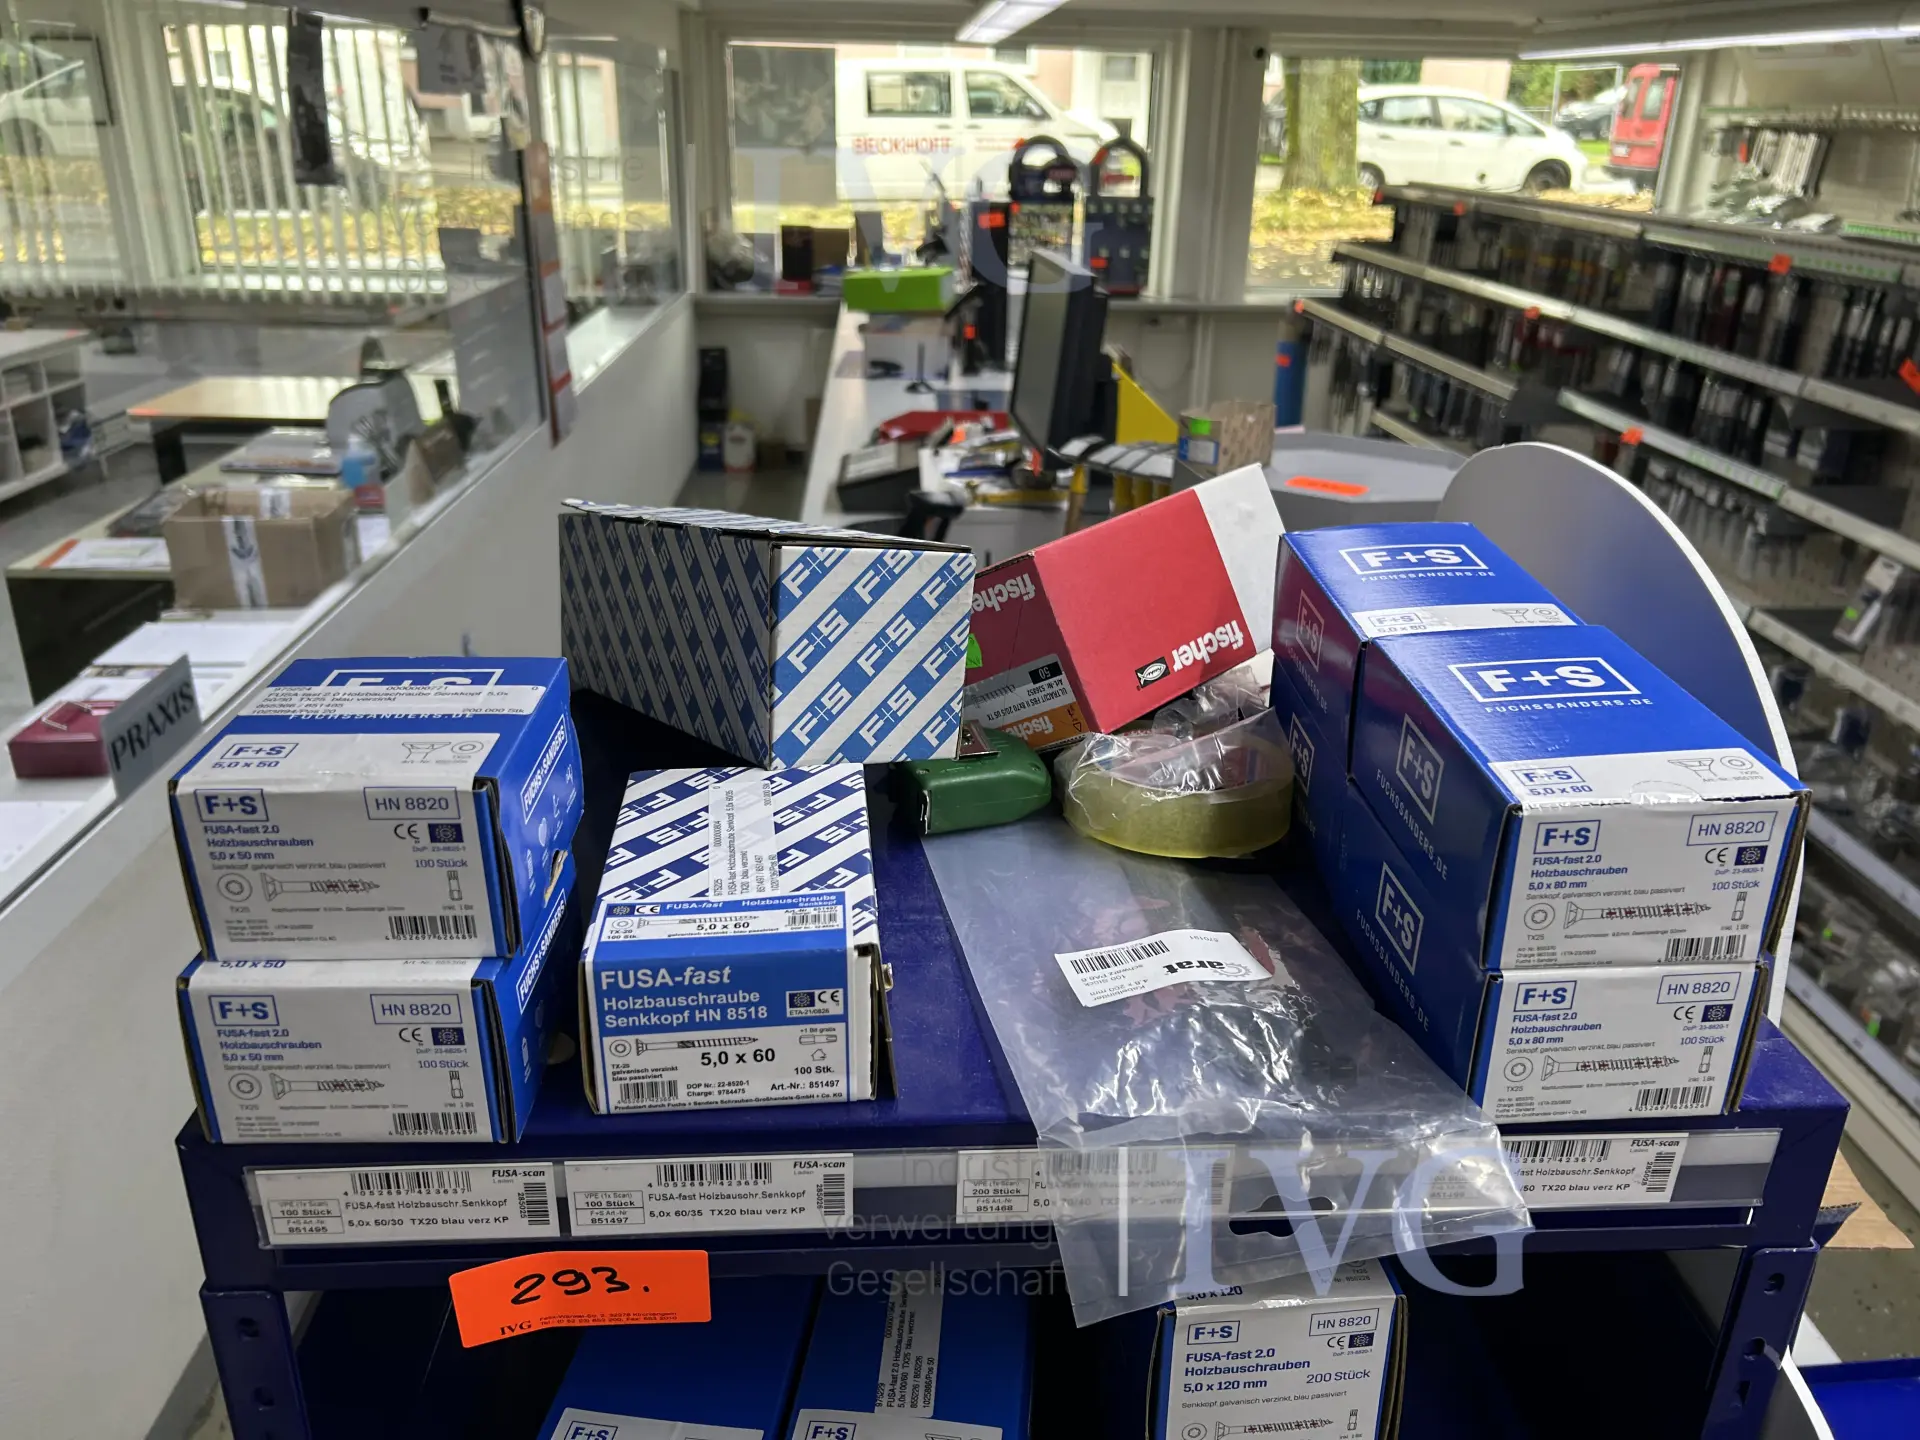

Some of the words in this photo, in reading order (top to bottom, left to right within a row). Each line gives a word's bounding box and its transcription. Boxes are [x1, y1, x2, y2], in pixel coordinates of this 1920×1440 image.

[1361, 549, 1463, 568] F+S
[1361, 571, 1496, 582] FUCHSSANDERS.DE
[787, 608, 849, 674] F+S
[857, 614, 917, 678] F+S
[1172, 620, 1245, 673] fischer
[1039, 667, 1051, 679] 50
[1477, 666, 1606, 693] F+S
[1485, 699, 1654, 713] FUCHSSANDERS.DE
[791, 682, 852, 747] F+S
[858, 685, 917, 748] F+S
[111, 681, 194, 773] PRAXIS
[231, 745, 287, 756] F+S
[212, 761, 240, 770] 5,0
[255, 760, 281, 769] 50
[1402, 735, 1435, 800] F+S
[1524, 769, 1574, 783] F+S
[203, 795, 258, 816] F+S
[375, 797, 400, 811] HN
[405, 797, 449, 811] 8820
[204, 825, 260, 835] FUSA-fast
[262, 824, 280, 834] 2.0
[1376, 769, 1449, 881] FUCHSSANDERS.DE
[1698, 823, 1721, 837] HN
[1725, 820, 1766, 835] 8820
[207, 838, 314, 848] Holzbauschrauben
[1543, 826, 1592, 848] F+S
[415, 859, 436, 868] 100
[437, 858, 469, 869] Stück
[1532, 856, 1584, 866] FUSA-fast
[1585, 855, 1603, 865] 2.0
[1530, 867, 1629, 879] Holzbauschrauben
[1528, 882, 1545, 893] 5,0
[1554, 881, 1567, 890] 80
[1568, 881, 1588, 889] mm
[1711, 882, 1731, 892] 100
[1731, 879, 1761, 891] Stück
[666, 901, 724, 910] FUSA-fast
[742, 895, 837, 909] Holzbauschraube
[1382, 883, 1415, 950] F+S
[696, 923, 718, 935] 5,0
[720, 924, 729, 932] x
[734, 921, 750, 931] 60
[519, 899, 566, 1002] FUCHS+SANDERS
[1162, 960, 1225, 976] arat
[600, 965, 732, 990] FUSA-fast
[1522, 986, 1569, 1005] F+S
[1667, 983, 1690, 996] HN
[1692, 981, 1731, 995] 8820
[603, 989, 761, 1011] Holzbauschraube
[218, 1001, 270, 1020] F+S
[381, 1003, 405, 1017] HN
[410, 1003, 452, 1016] 8820
[605, 1010, 690, 1028] Senkkopf
[695, 1008, 721, 1023] HN
[726, 1006, 768, 1021] 8518
[1512, 1013, 1561, 1023] FUSA-fast
[1562, 1012, 1578, 1021] 2.0
[217, 1029, 271, 1038] FUSA-fast
[273, 1028, 290, 1037] 2.0
[1510, 1023, 1602, 1035] Holzbauschrauben
[220, 1041, 323, 1050] Holzbauschrauben
[1508, 1038, 1523, 1048] 5,0
[1532, 1037, 1545, 1046] 80
[1546, 1037, 1564, 1045] mm
[1680, 1037, 1699, 1046] 100
[1698, 1034, 1727, 1045] Stück
[419, 1060, 438, 1070] 100
[439, 1058, 470, 1070] Stück
[700, 1051, 729, 1069] 5,0
[735, 1053, 748, 1065] x
[752, 1048, 776, 1064] 60
[611, 1067, 650, 1077] galvanisch
[650, 1065, 679, 1074] verzinkt
[794, 1066, 812, 1076] 100
[815, 1065, 835, 1074] Stk.
[808, 1080, 840, 1091] 851497
[1630, 1139, 1681, 1148] FUSA-scan
[793, 1160, 846, 1170] FUSA-scan
[491, 1168, 546, 1179] FUSA-scan
[972, 1188, 991, 1196] 200
[993, 1187, 1022, 1196] Stück
[1592, 1184, 1613, 1192] verz
[1615, 1183, 1631, 1191] KP
[648, 1192, 697, 1203] FUSA-fast
[698, 1190, 807, 1202] Holzbauschr.Senkkopf
[345, 1200, 396, 1210] FUSA-fast
[396, 1199, 509, 1210] Holzbauschr.Senkkopf
[584, 1200, 604, 1208] 100
[605, 1199, 636, 1209] Stück
[976, 1204, 1014, 1213] 851468
[280, 1209, 301, 1217] 100
[302, 1208, 334, 1216] Stück
[650, 1210, 672, 1221] 5,0x
[673, 1208, 704, 1218] 60/35
[708, 1208, 737, 1217] TX20
[738, 1207, 762, 1216] blau
[764, 1208, 789, 1216] verz
[790, 1206, 807, 1216] KP
[348, 1218, 371, 1229] 5,0x
[373, 1217, 405, 1227] 50/30
[409, 1217, 439, 1226] TX20
[440, 1216, 465, 1225] blau
[466, 1217, 490, 1225] verz
[492, 1215, 510, 1224] KP
[590, 1217, 630, 1226] 851497
[287, 1225, 329, 1235] 851495
[510, 1265, 651, 1306] 293.
[499, 1318, 533, 1337] IVG
[1316, 1319, 1337, 1331] HN
[1337, 1315, 1373, 1328] 8820
[1193, 1325, 1234, 1341] F+S
[1185, 1349, 1254, 1363] FUSA-fast
[1255, 1347, 1277, 1359] 2.0
[1184, 1359, 1312, 1378] Holzbauschrauben
[1305, 1373, 1333, 1386] 200
[1333, 1368, 1372, 1382] Stück
[1183, 1381, 1204, 1396] 5,0
[1205, 1382, 1215, 1391] x
[1216, 1379, 1241, 1390] 120
[1242, 1378, 1268, 1388] mm
